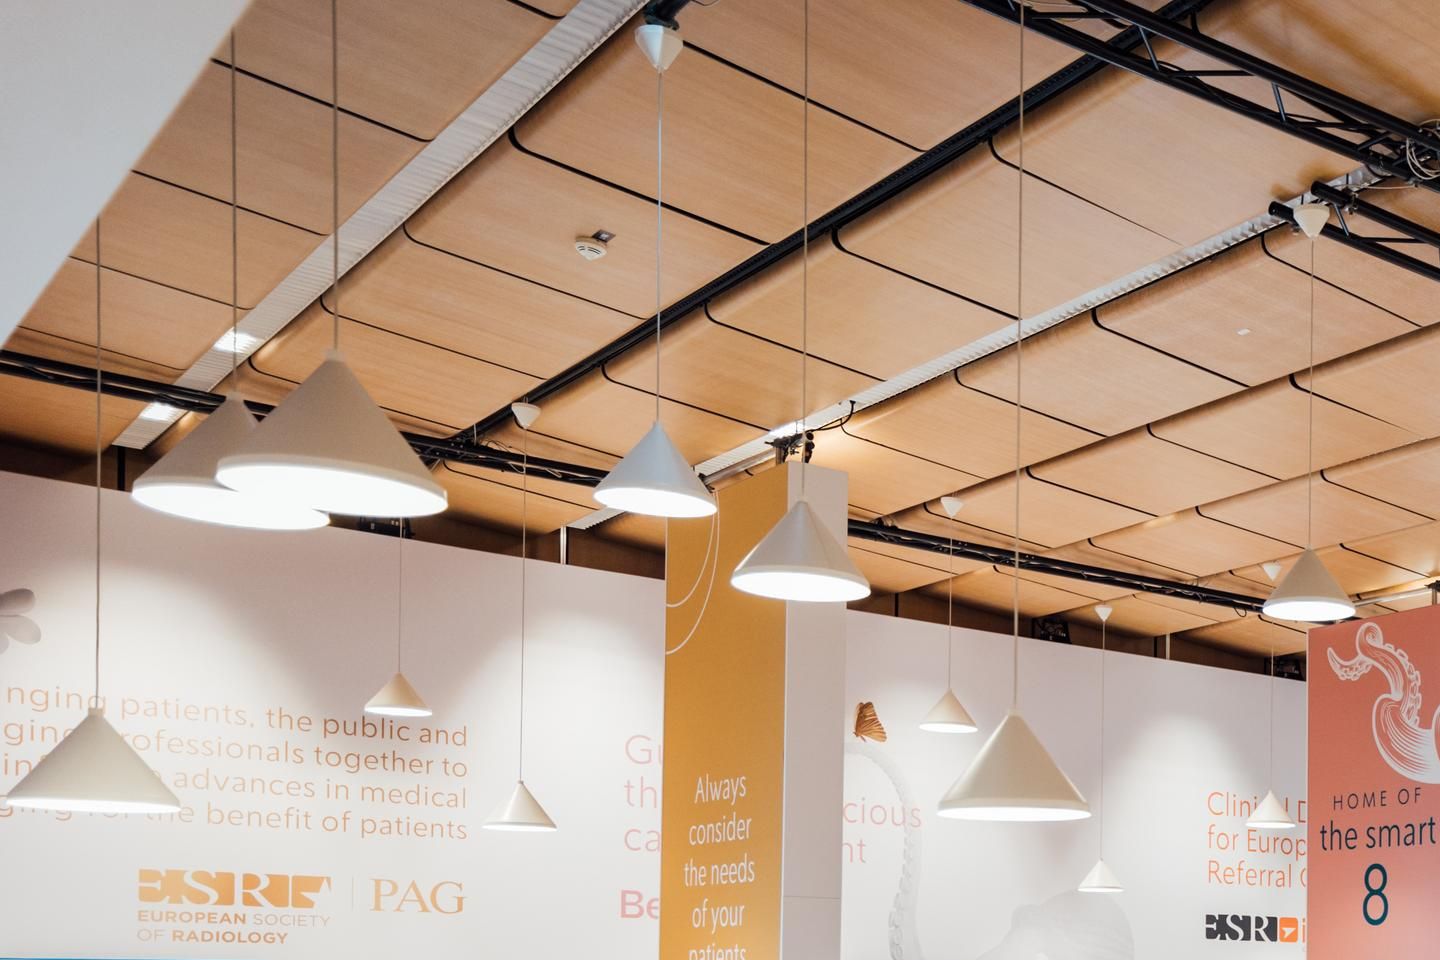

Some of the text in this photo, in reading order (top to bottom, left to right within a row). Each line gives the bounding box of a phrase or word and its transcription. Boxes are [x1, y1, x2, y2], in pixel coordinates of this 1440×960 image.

[266, 707, 312, 732] the
[323, 716, 411, 742] public
[419, 726, 467, 746] and
[121, 728, 304, 764] rofessionals
[314, 747, 434, 774] together
[442, 758, 468, 778] to
[173, 768, 315, 798] advances
[326, 778, 349, 800] in
[361, 784, 467, 808] medical
[694, 773, 747, 805] Always
[1207, 791, 1289, 817] Clinil
[1333, 787, 1422, 811] HOME OF
[207, 802, 312, 830] benefit
[322, 811, 352, 833] of
[361, 816, 467, 840] patients
[689, 813, 752, 846] consider
[1208, 824, 1239, 851] for
[1320, 816, 1436, 851] the smart
[684, 853, 755, 887] the needs
[1208, 860, 1292, 888] Referral
[369, 877, 469, 915] PAG
[1362, 863, 1389, 926] 8
[137, 910, 331, 928] EUROPEAN SOCIETY
[692, 899, 745, 934] of your
[1205, 914, 1278, 942] ESR
[137, 929, 288, 945] OF RADIOLOGY
